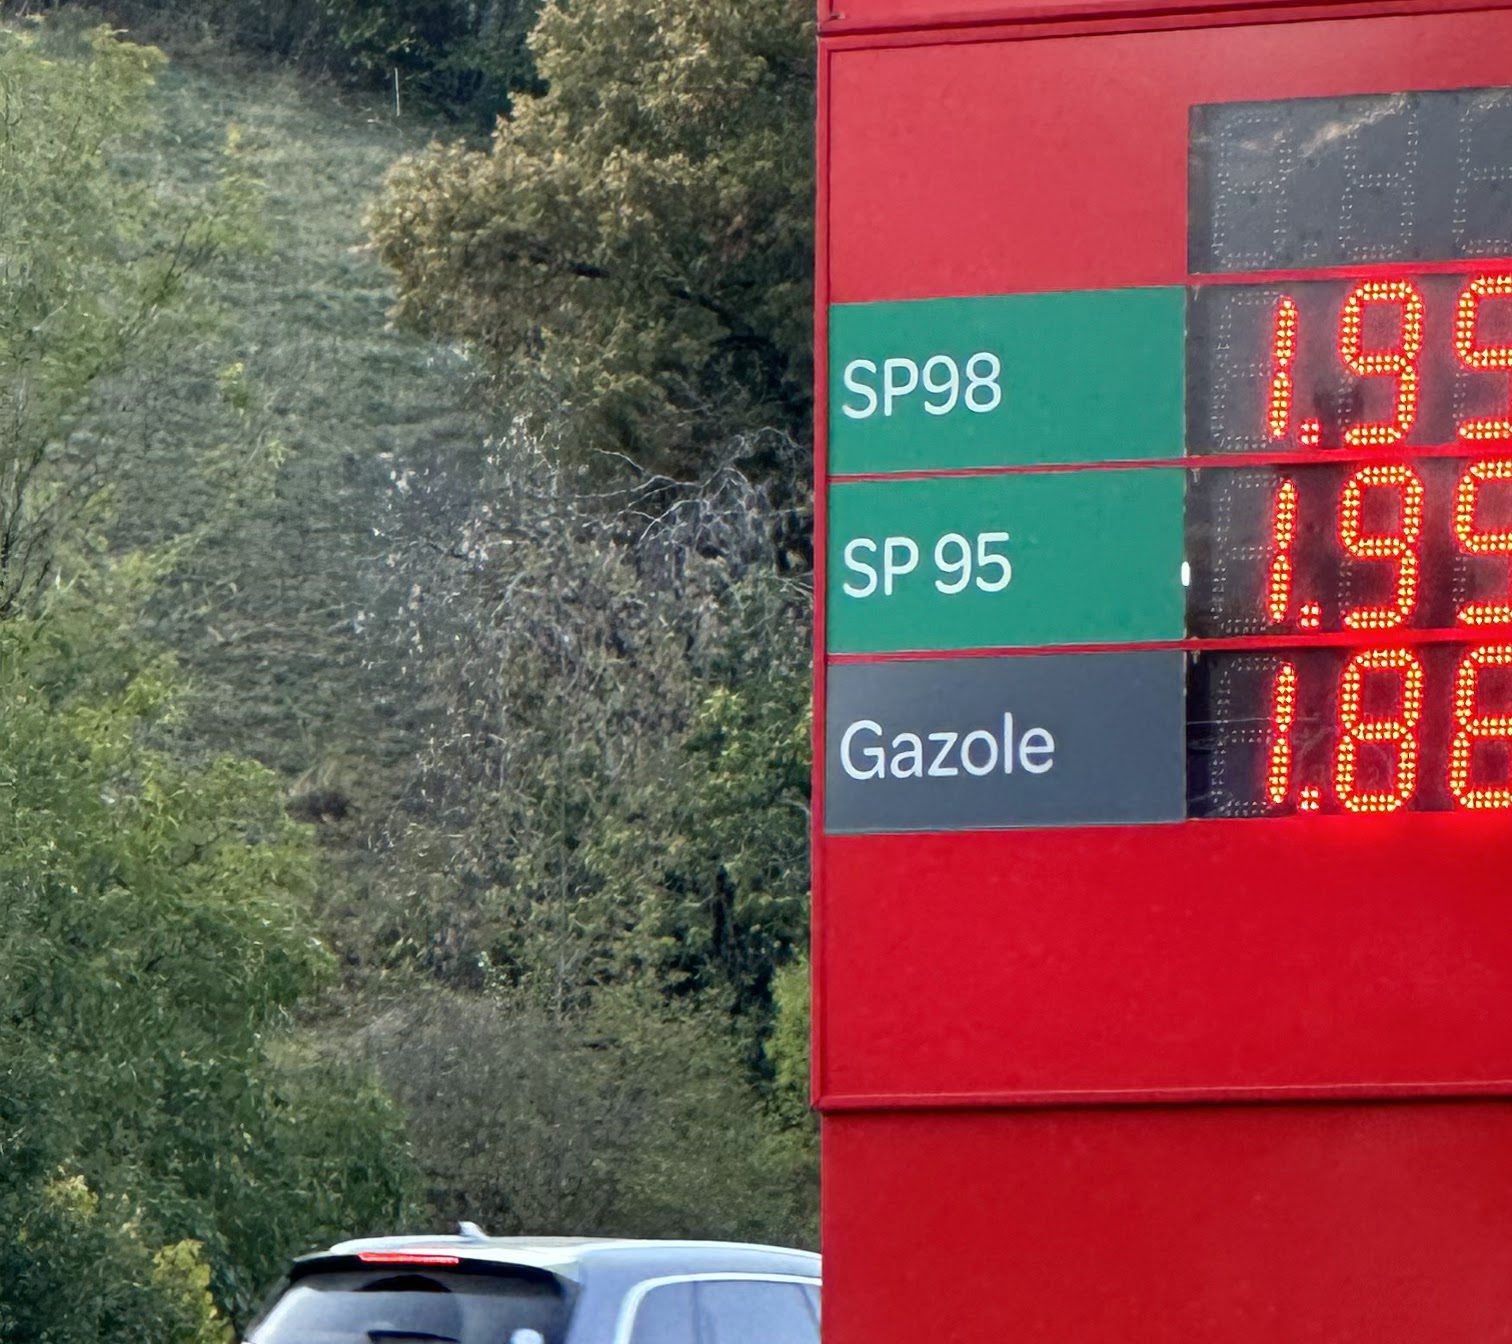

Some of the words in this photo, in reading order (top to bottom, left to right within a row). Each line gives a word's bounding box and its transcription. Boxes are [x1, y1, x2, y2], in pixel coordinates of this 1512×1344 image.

[842, 352, 1001, 419] SP98
[842, 537, 919, 597] SP
[934, 532, 1012, 593] 95
[839, 712, 1055, 780] Gazole
